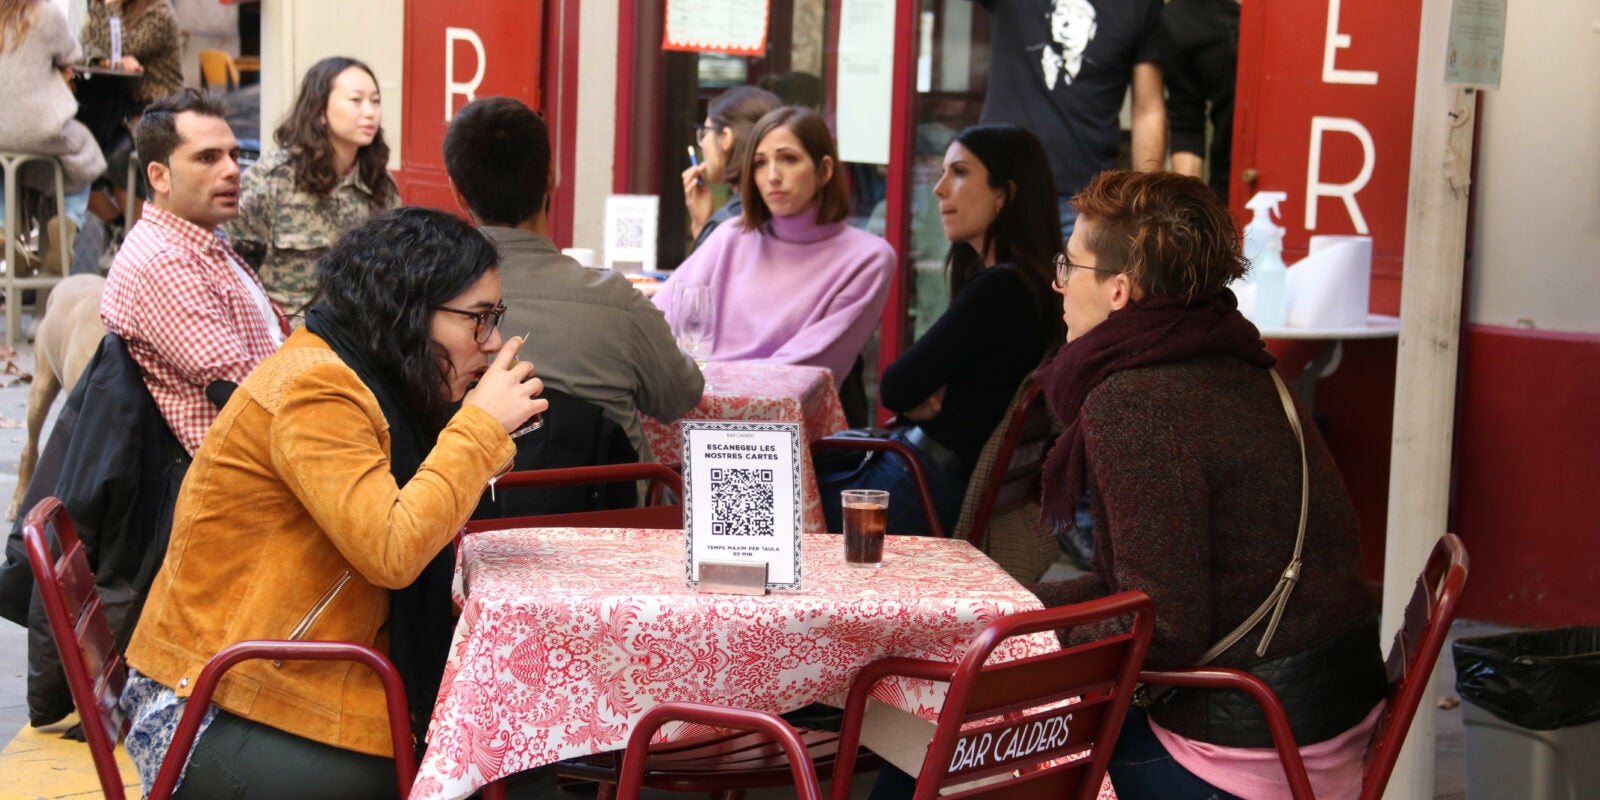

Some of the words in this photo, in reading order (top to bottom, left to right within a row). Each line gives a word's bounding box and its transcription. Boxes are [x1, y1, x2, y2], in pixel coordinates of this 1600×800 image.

[445, 26, 487, 122] R
[704, 452, 743, 460] NOSTRES
[745, 453, 779, 461] CARTES
[707, 443, 757, 452] ESCANEGEU
[948, 732, 993, 773] BAR
[993, 713, 1073, 762] CALDERS
